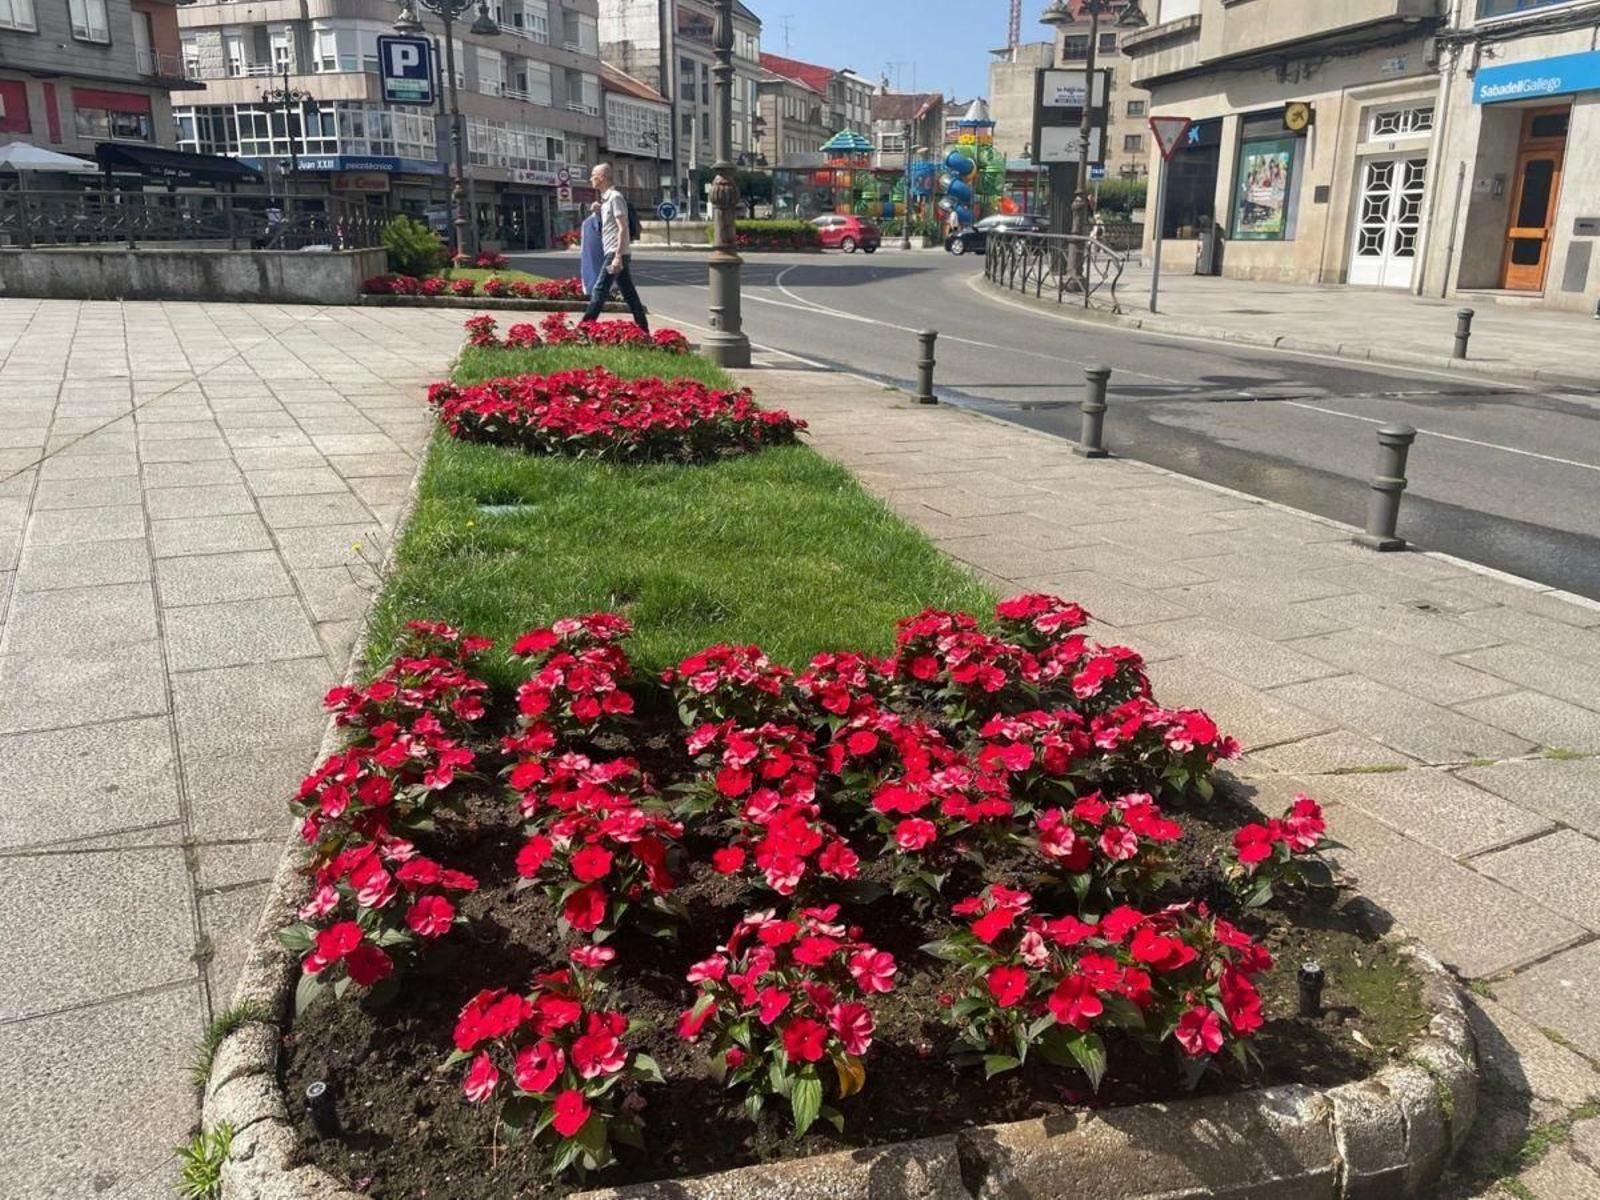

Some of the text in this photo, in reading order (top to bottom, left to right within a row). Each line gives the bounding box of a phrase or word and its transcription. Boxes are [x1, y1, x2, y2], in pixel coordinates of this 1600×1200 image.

[391, 44, 419, 76] P
[298, 160, 334, 170] Juan XXIII
